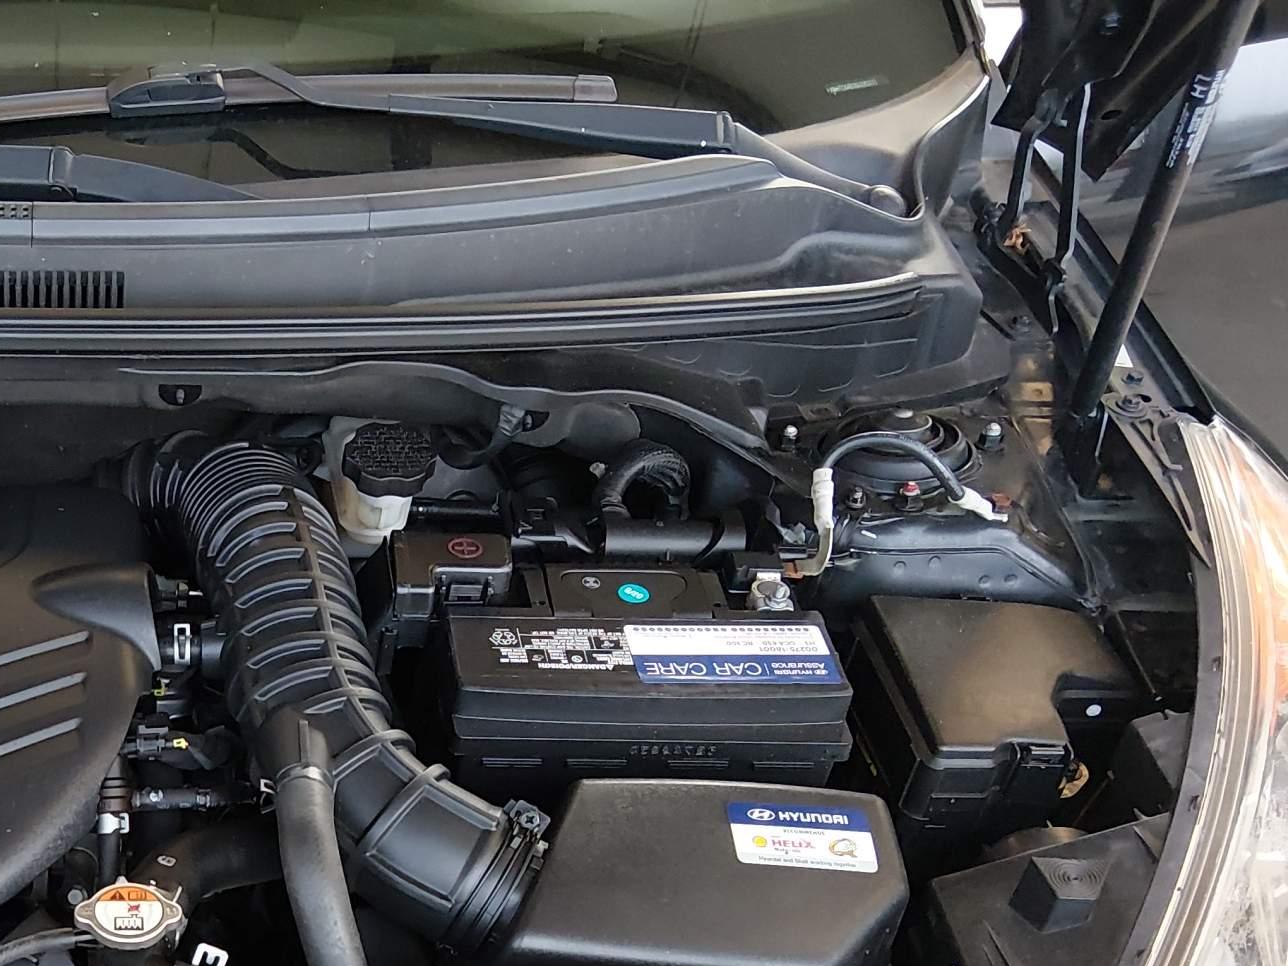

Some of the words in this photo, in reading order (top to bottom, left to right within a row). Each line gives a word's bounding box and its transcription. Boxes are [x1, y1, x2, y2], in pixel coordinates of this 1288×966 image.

[643, 662, 707, 676] CARE
[713, 662, 762, 676] CAR
[778, 811, 849, 825] HYUNDAI
